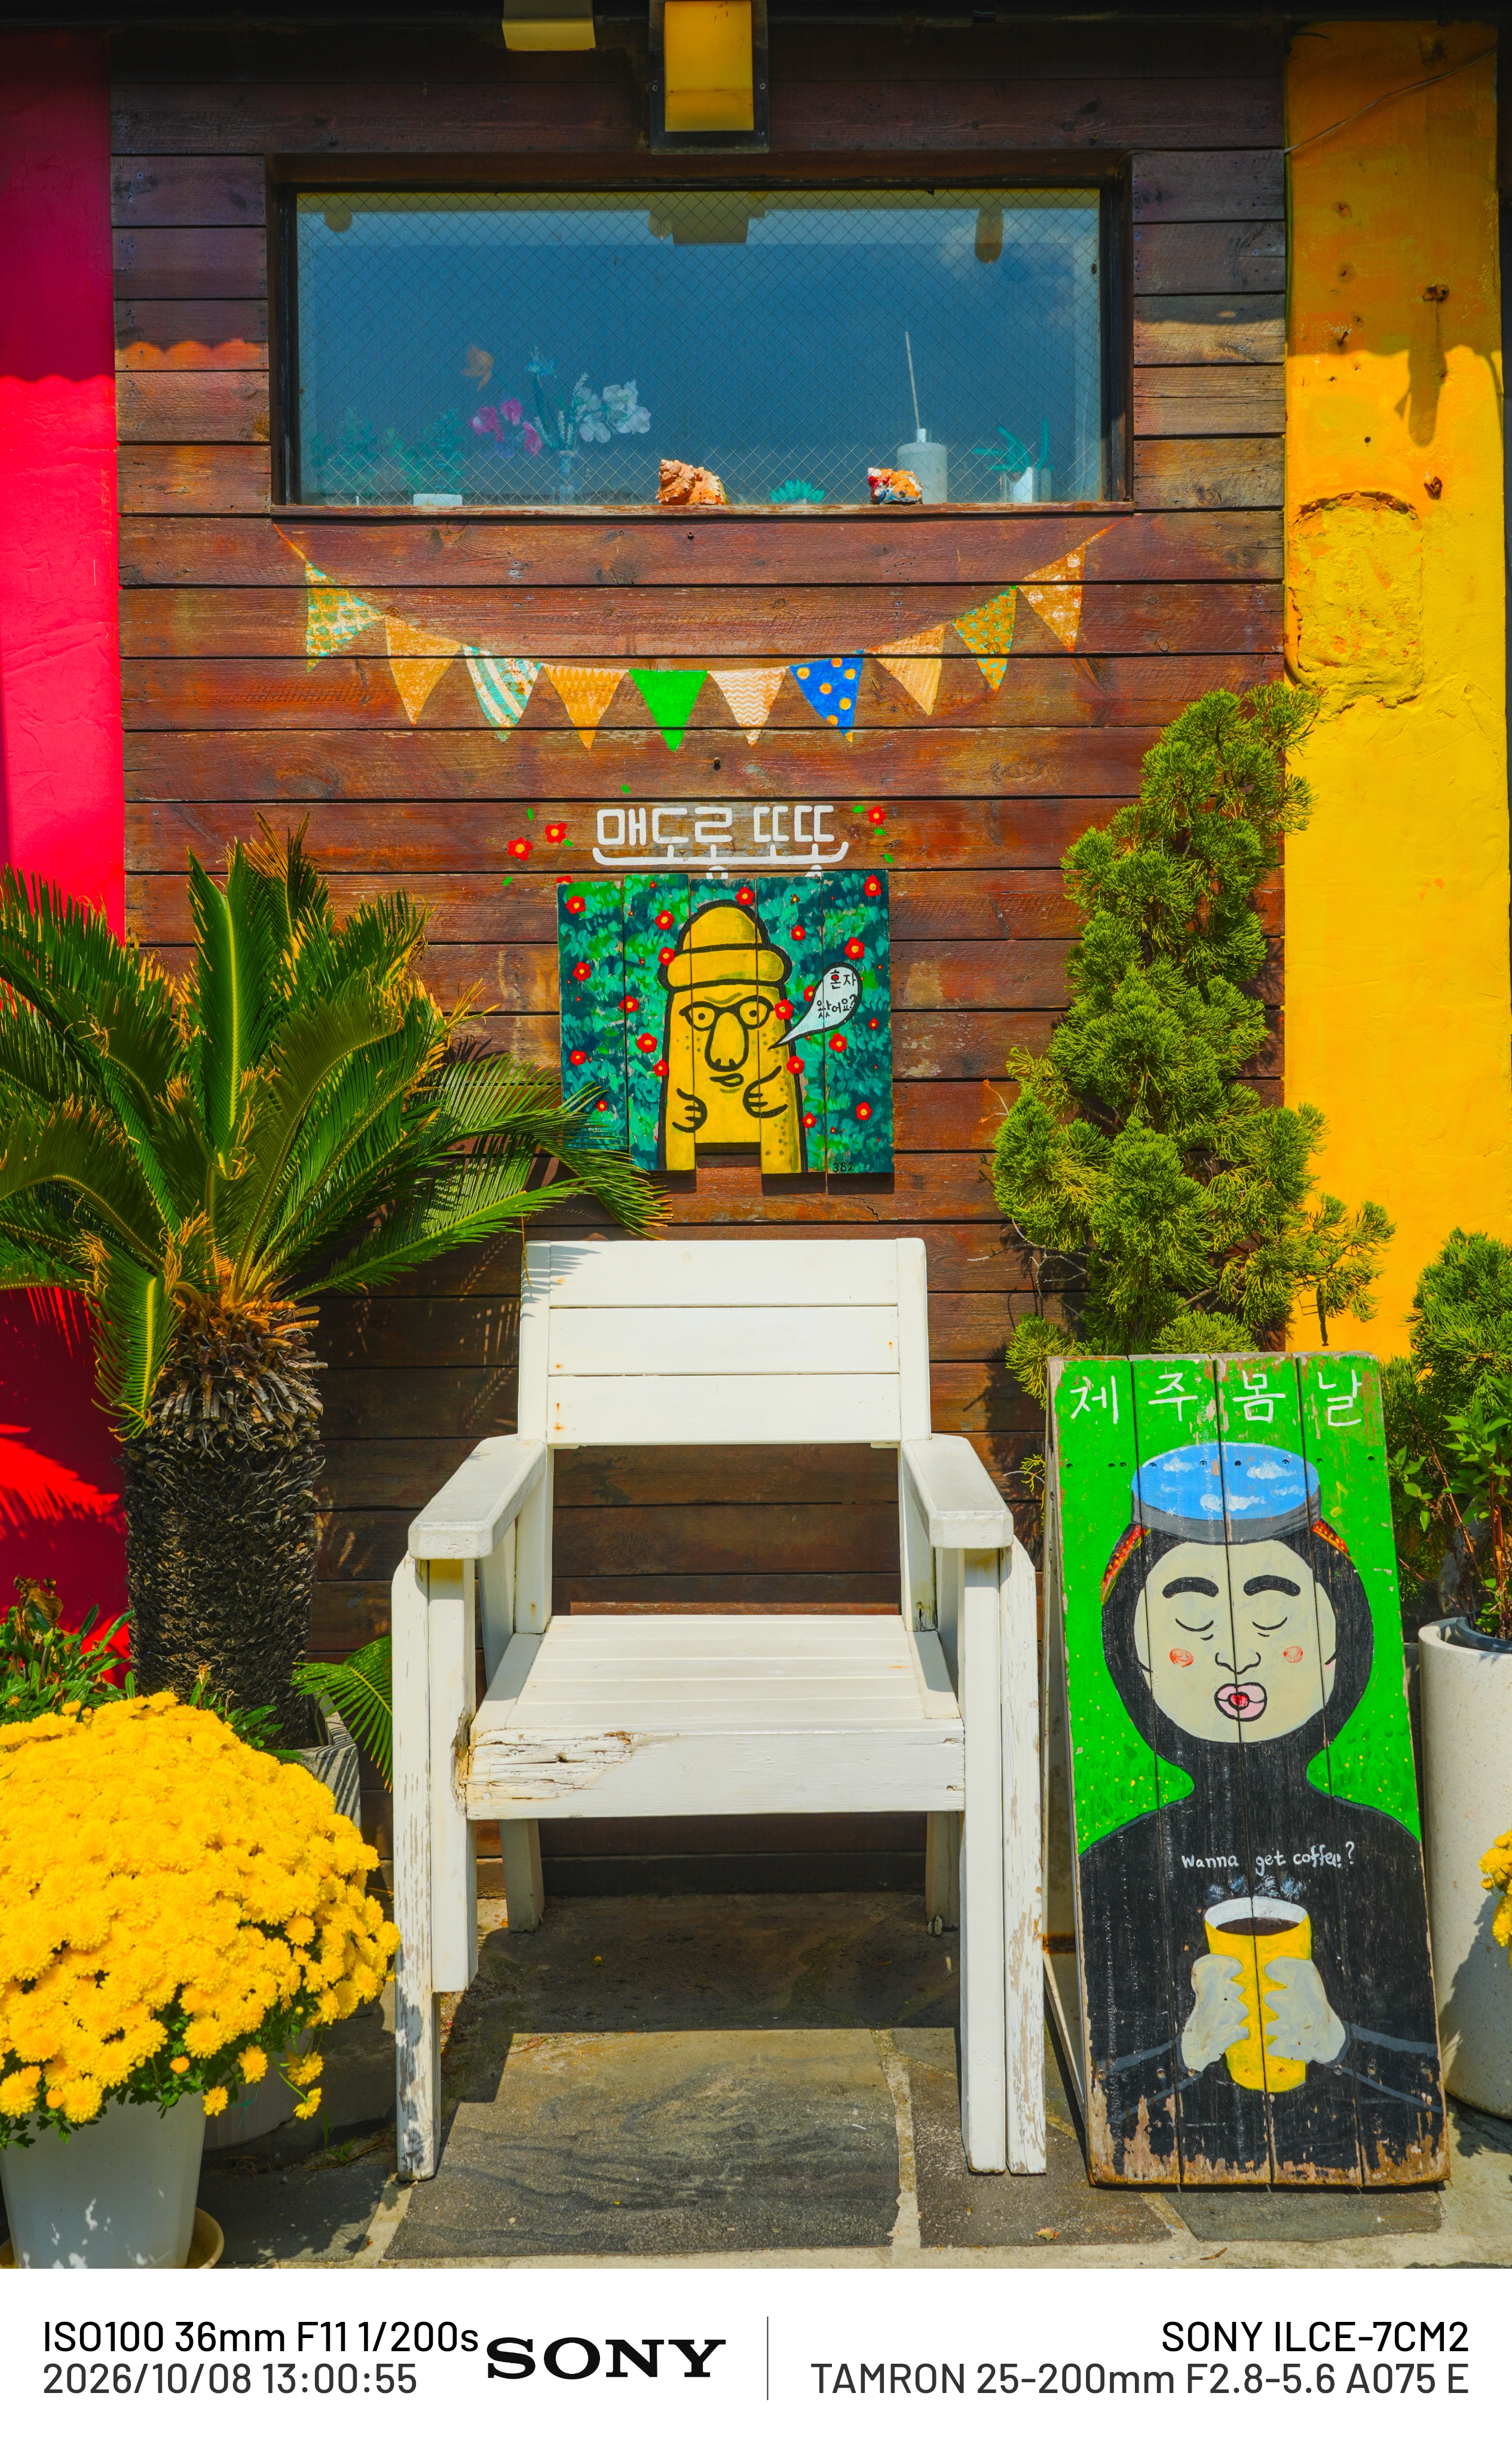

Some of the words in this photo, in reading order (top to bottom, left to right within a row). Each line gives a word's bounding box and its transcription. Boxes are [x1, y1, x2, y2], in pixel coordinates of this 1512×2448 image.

[830, 969, 856, 990] 혼자
[817, 993, 858, 1019] 왔어요?
[832, 1161, 854, 1173] 382
[1255, 1850, 1286, 1877] get
